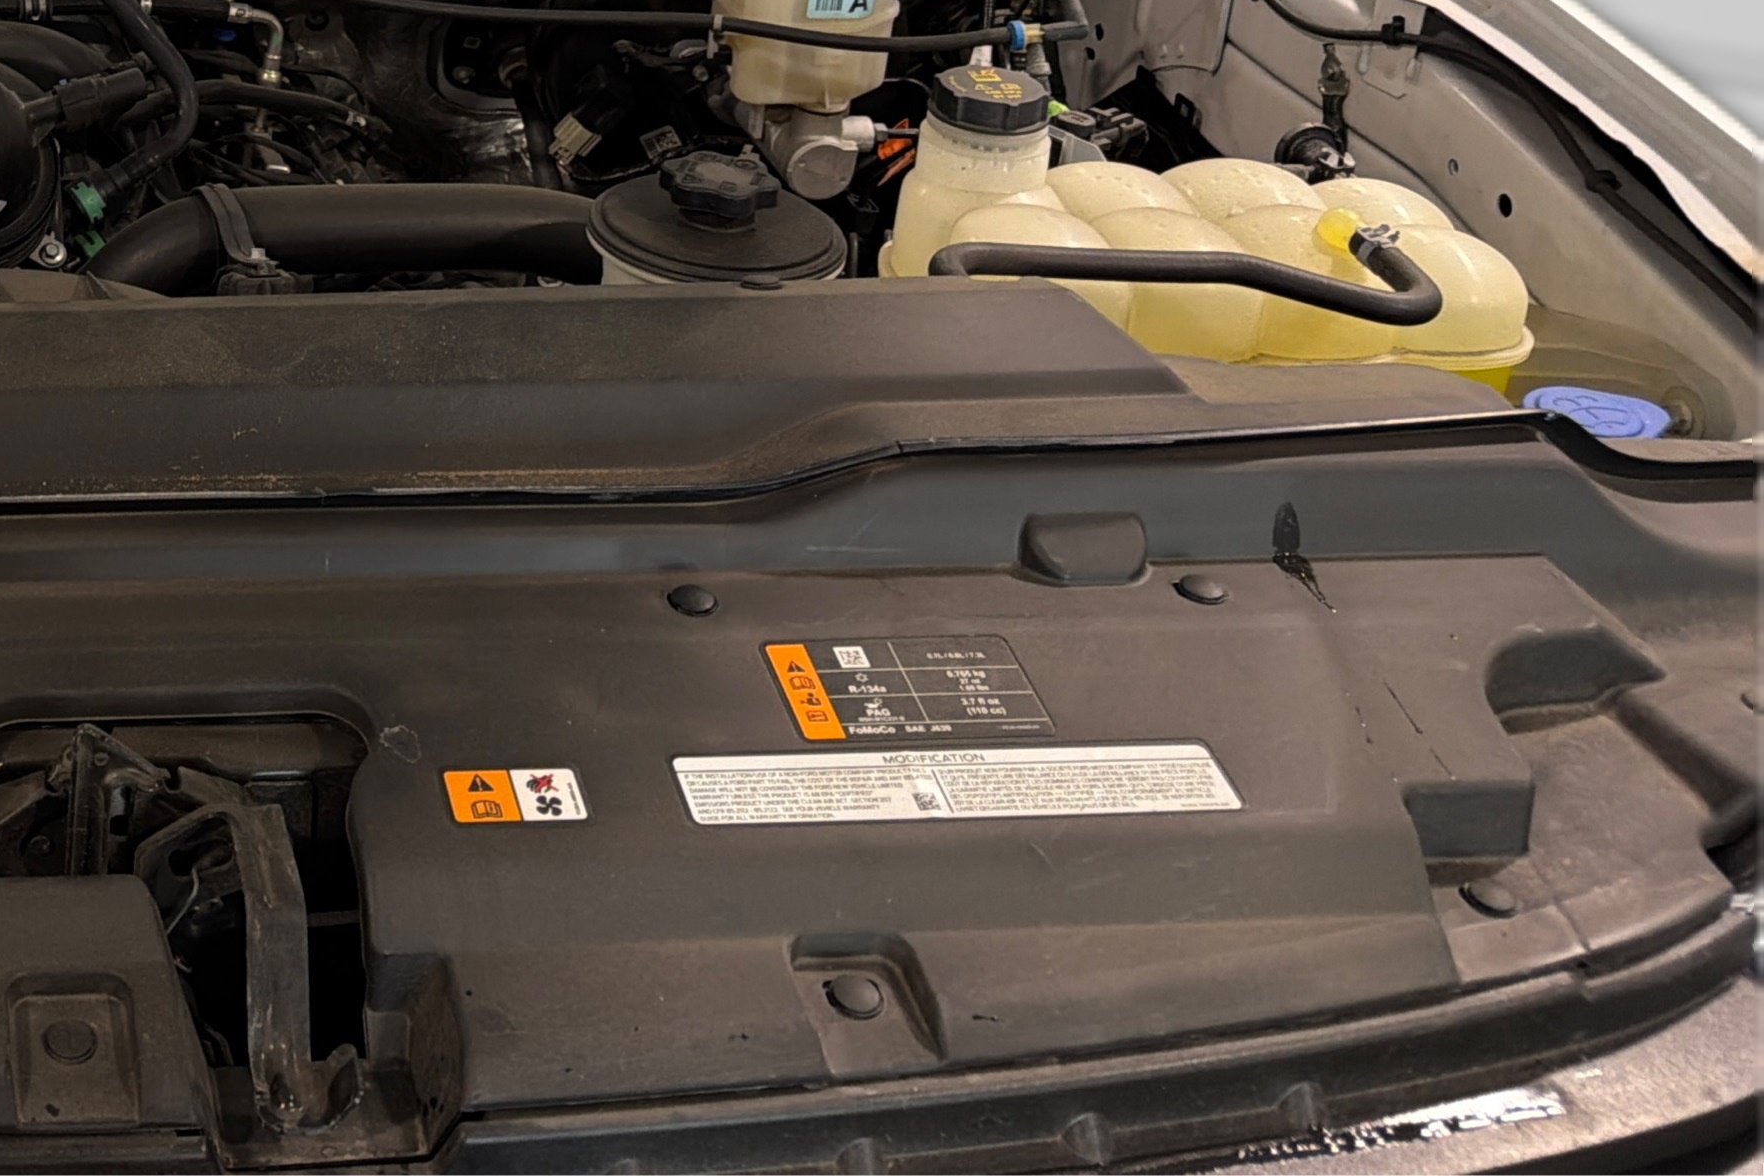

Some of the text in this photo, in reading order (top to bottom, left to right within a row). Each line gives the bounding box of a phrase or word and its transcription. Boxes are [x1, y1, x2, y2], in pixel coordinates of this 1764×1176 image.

[848, 685, 887, 694] R-134a
[867, 709, 891, 717] PAG
[849, 726, 896, 735] FoMoCo
[882, 753, 986, 765] MODIFICATION
